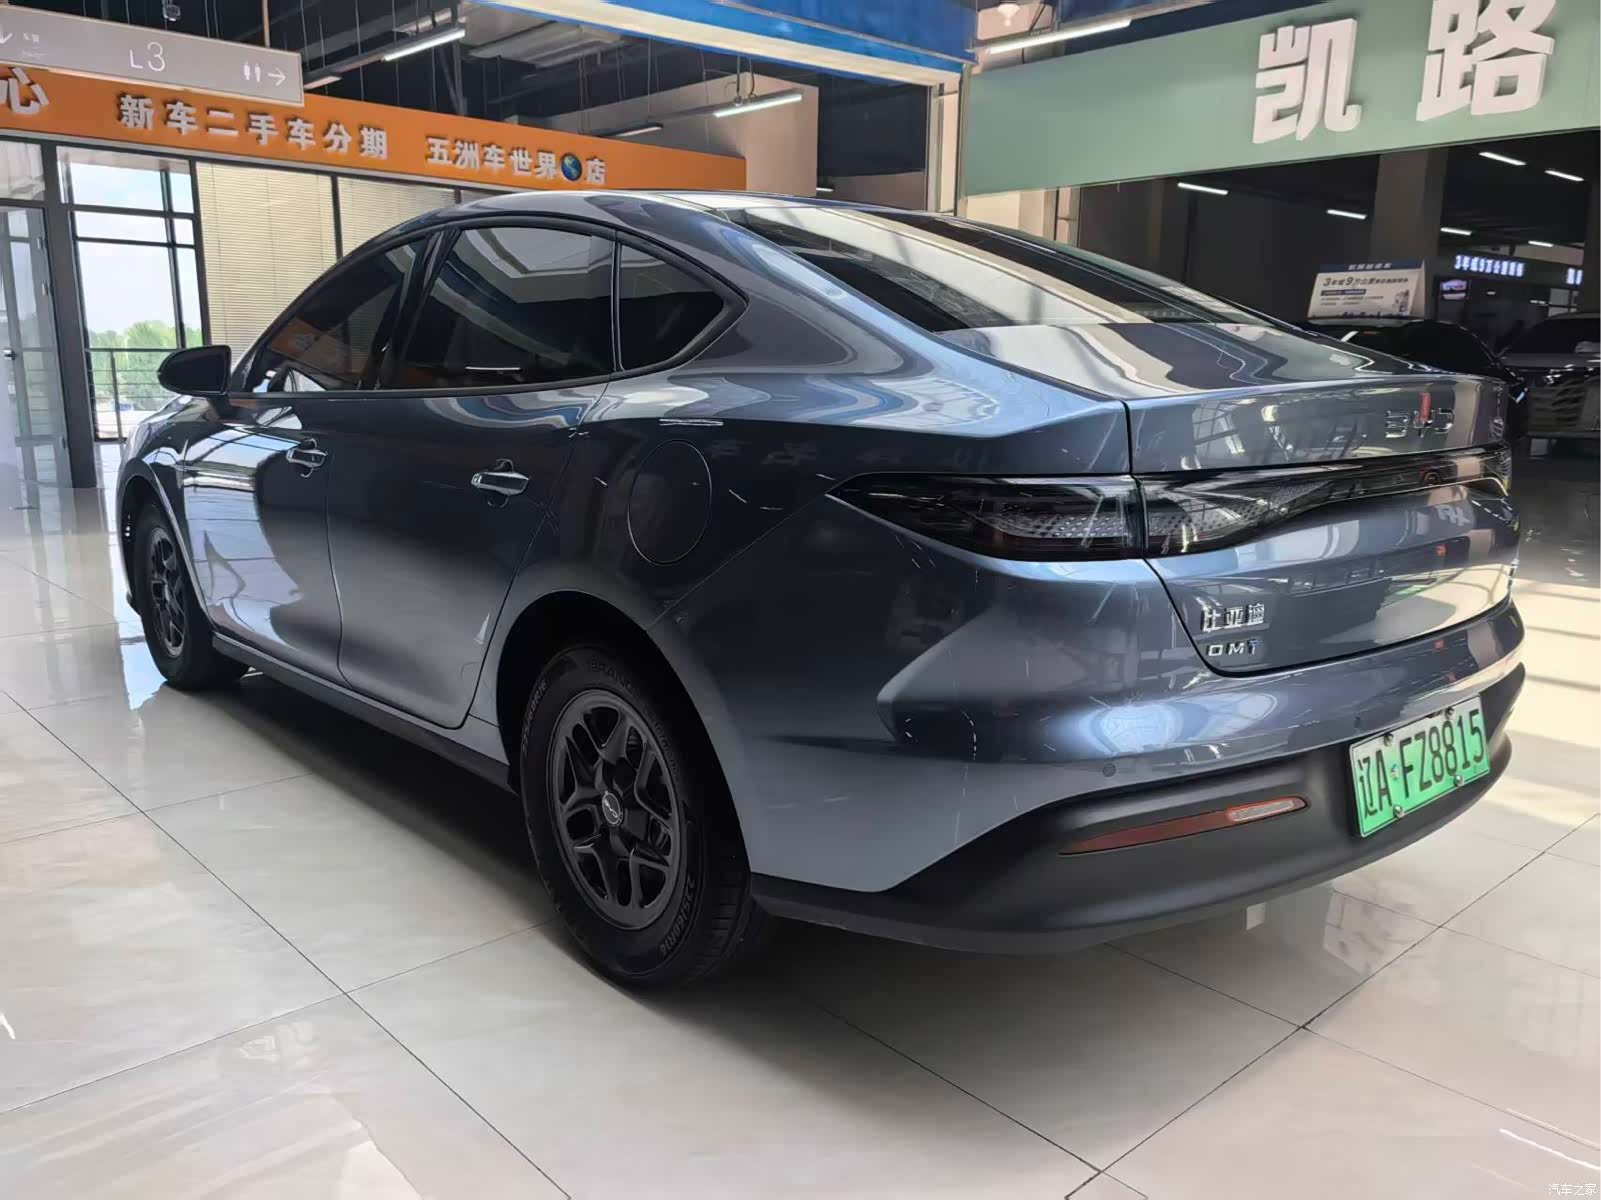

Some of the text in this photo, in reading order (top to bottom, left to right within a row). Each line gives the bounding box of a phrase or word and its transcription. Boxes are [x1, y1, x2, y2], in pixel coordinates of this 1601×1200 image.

[129, 42, 166, 72] L3
[1252, 0, 1555, 144] 凯路
[0, 67, 49, 115] 心
[118, 94, 388, 160] 新车二手车分期
